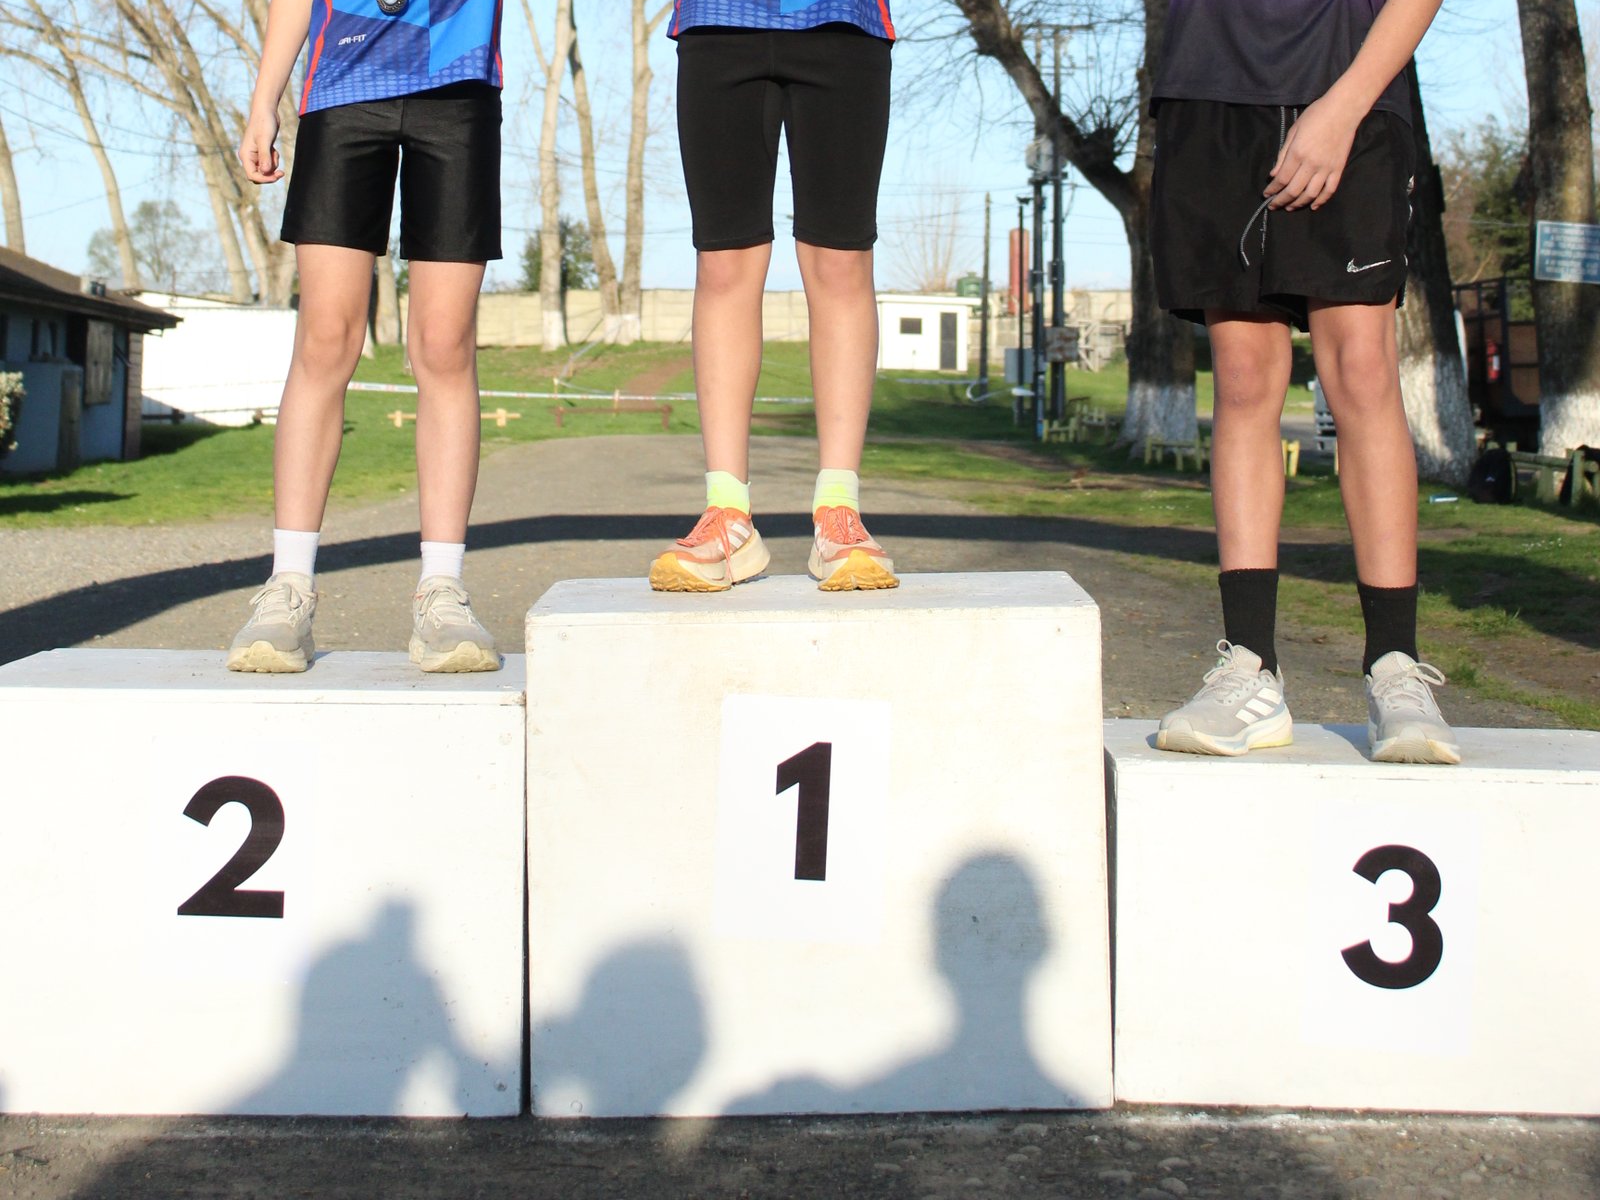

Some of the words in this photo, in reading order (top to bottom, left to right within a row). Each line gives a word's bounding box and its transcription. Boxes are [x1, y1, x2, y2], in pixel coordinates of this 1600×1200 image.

[177, 775, 285, 919] 2
[776, 741, 832, 881] 1
[1340, 844, 1443, 990] 3
